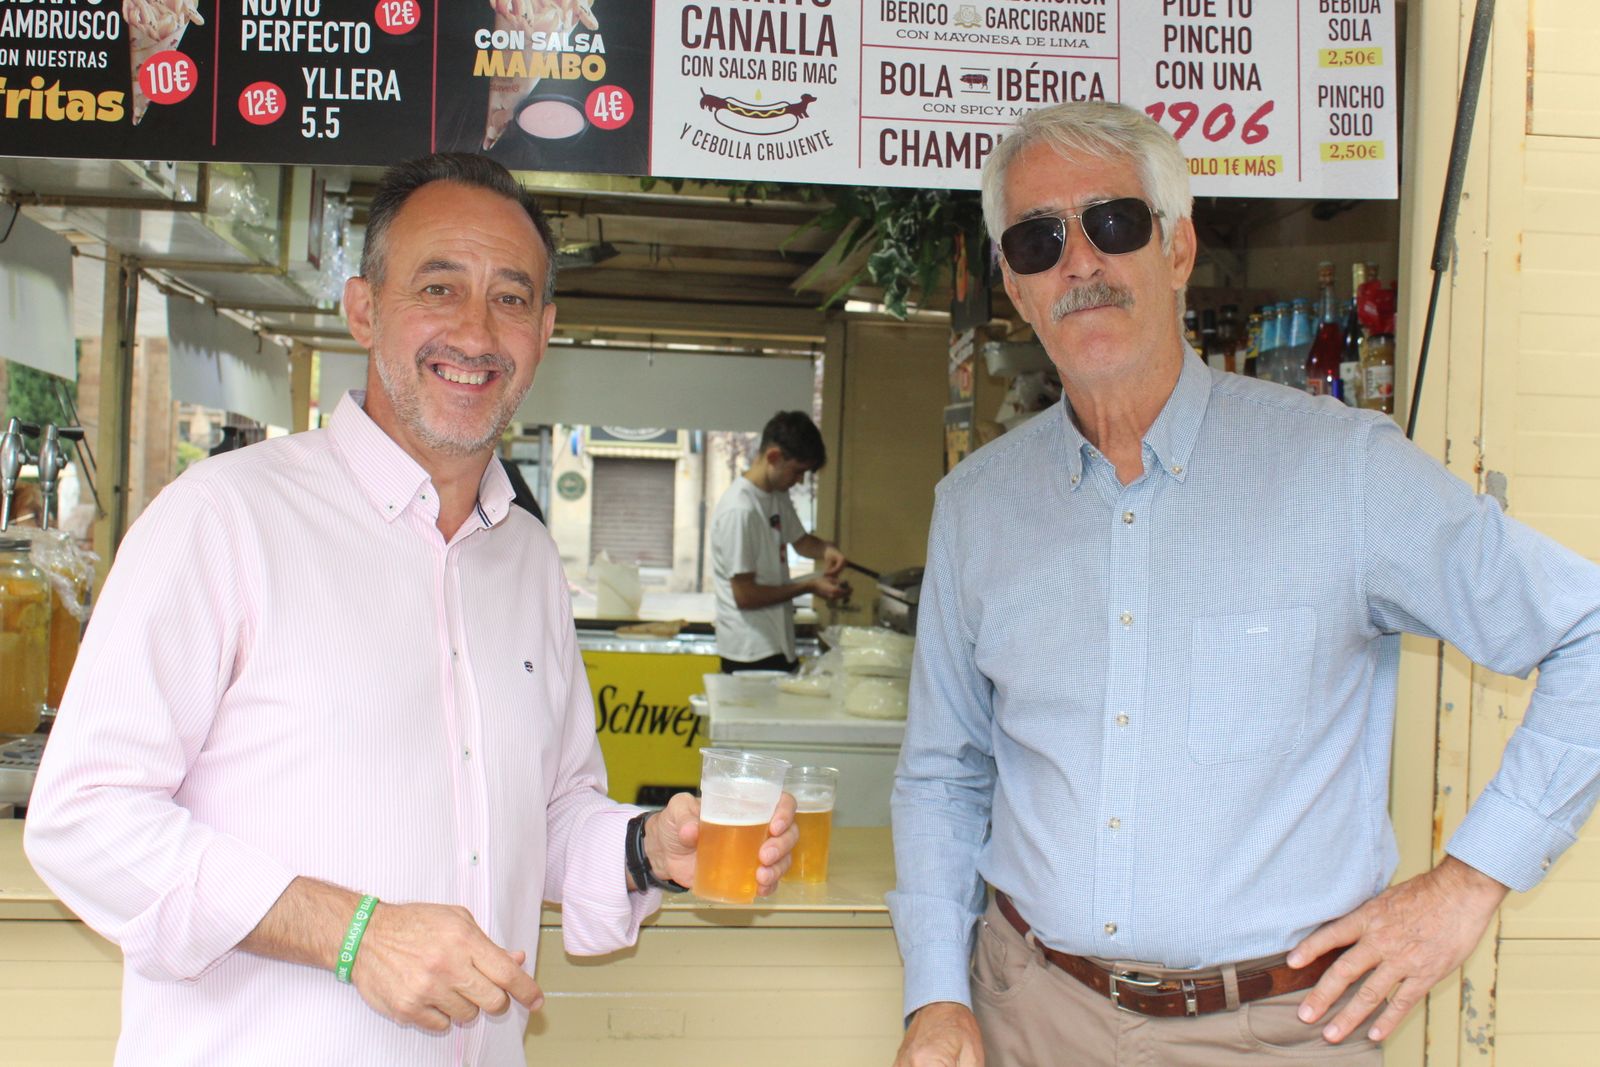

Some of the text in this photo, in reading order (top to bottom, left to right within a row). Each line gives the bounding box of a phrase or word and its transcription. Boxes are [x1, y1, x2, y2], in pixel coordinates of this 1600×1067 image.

[382, 2, 415, 27] 12€
[985, 7, 1106, 34] GARCIGRANDE
[1163, 0, 1216, 18] PIDE
[1319, 0, 1381, 14] BEBIDA
[241, 20, 371, 54] PERFECTO
[474, 28, 606, 54] CON SALSA
[681, 4, 838, 57] CANALLA
[896, 29, 1090, 49] CON MAYONESA DE LIMA
[1164, 25, 1252, 54] PINCHO
[1328, 19, 1372, 41] SOLA
[26, 49, 108, 68] NUESTRAS
[473, 51, 607, 81] MAMBO
[681, 55, 838, 85] CON SALSA BIG MAC
[1327, 51, 1376, 65] 2,50€
[146, 60, 191, 95] 10€
[302, 67, 401, 102] YLLERA
[880, 61, 1105, 103] BOLA IBÉRICA
[1155, 60, 1262, 91] CON UNA
[244, 88, 279, 117] 12€
[593, 92, 625, 122] 4€
[923, 103, 956, 114] CON
[960, 105, 1004, 116] SPICY
[1318, 85, 1384, 108] PINCHO
[301, 107, 340, 138] 5.5
[1145, 100, 1274, 144] 1906
[1329, 113, 1373, 136] SOLO
[679, 123, 833, 161] Y CEBOLLA CRUJIENTE
[879, 128, 1003, 169] CHAMP
[1329, 145, 1377, 159] 2,50€
[1223, 158, 1240, 176] 1€
[1245, 155, 1277, 176] MÁS
